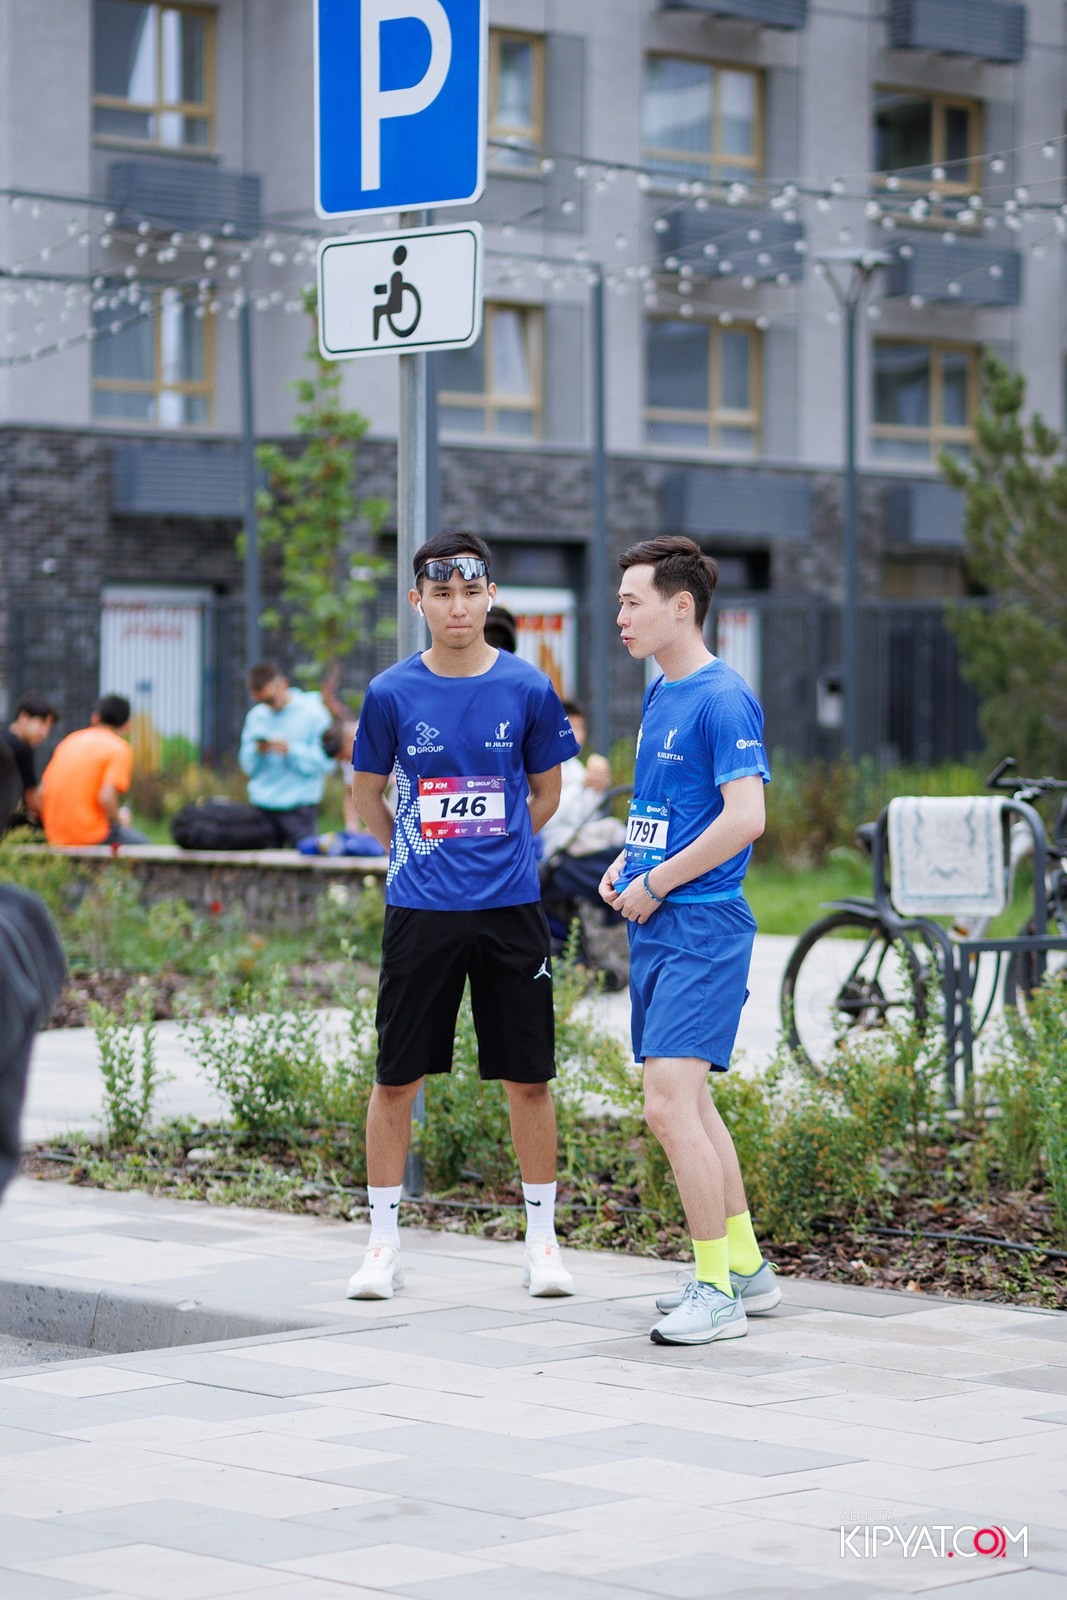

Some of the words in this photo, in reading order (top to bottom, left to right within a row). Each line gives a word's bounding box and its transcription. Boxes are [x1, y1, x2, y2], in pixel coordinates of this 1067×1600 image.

[360, 0, 452, 191] P
[417, 745, 444, 754] GROUP
[422, 781, 434, 790] 10
[435, 782, 448, 790] KM
[440, 795, 488, 818] 146
[629, 819, 659, 844] 1791
